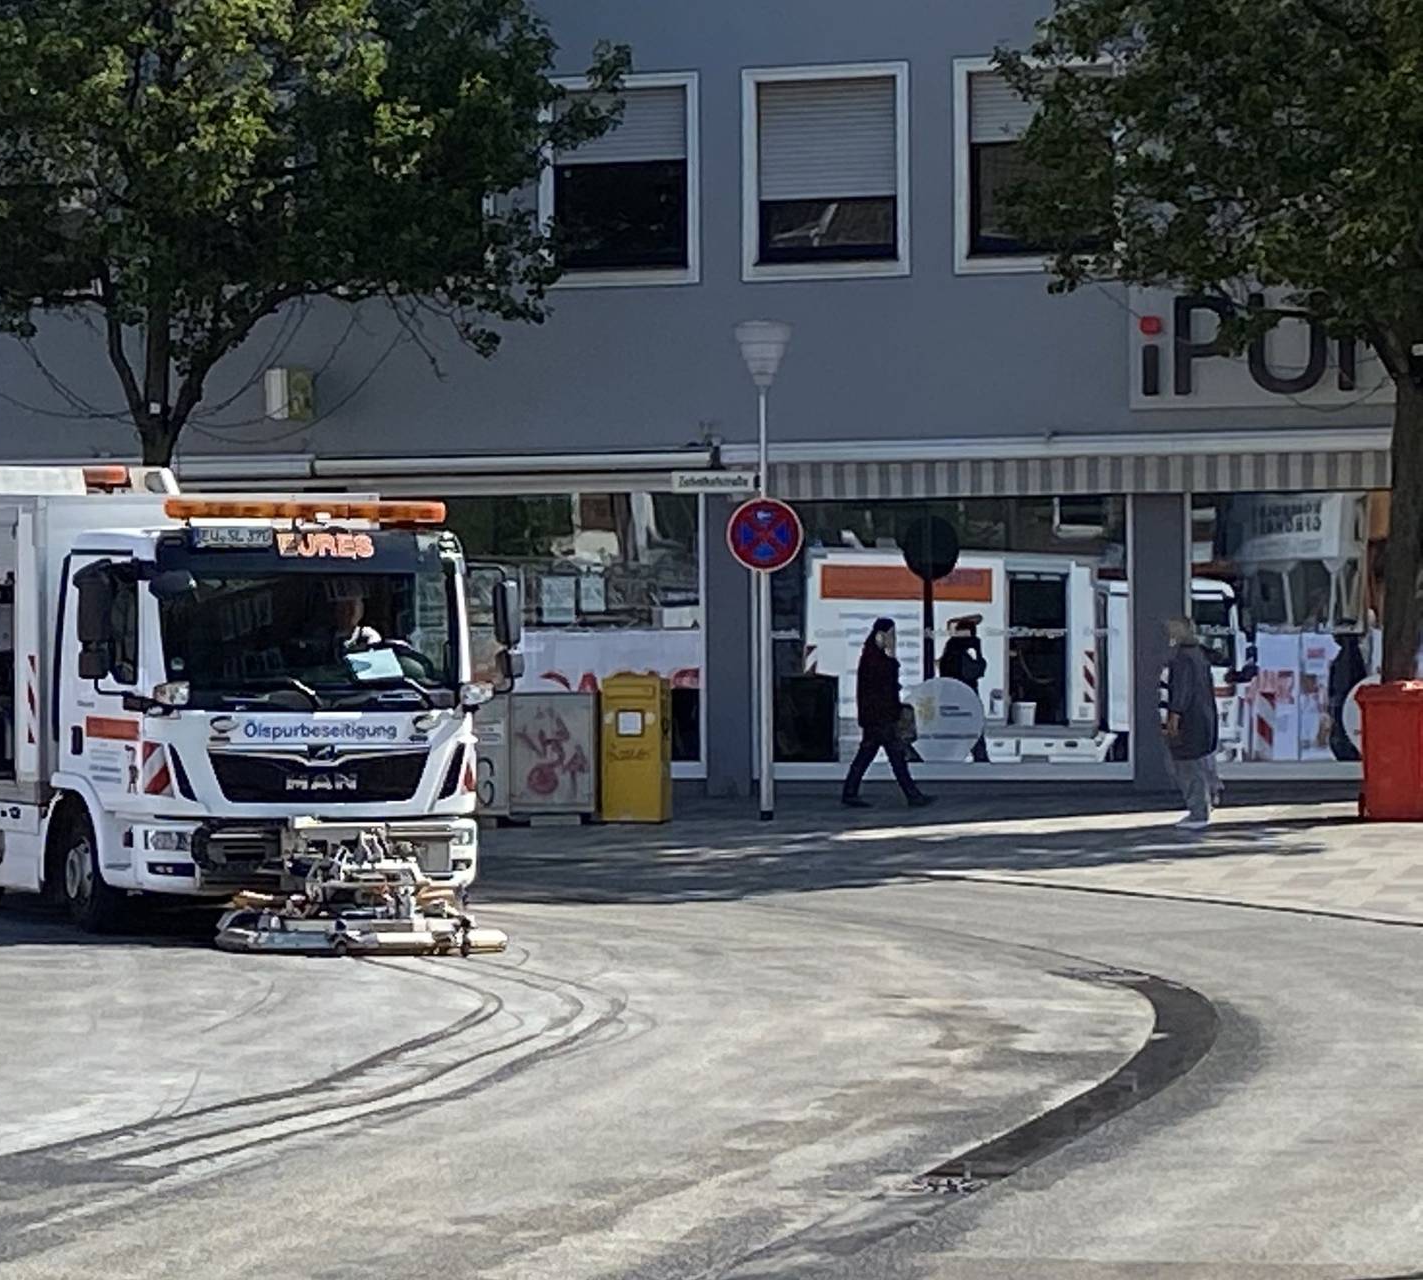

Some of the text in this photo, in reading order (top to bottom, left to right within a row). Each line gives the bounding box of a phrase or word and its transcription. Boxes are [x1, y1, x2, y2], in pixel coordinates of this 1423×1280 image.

[276, 532, 375, 558] EURES
[243, 719, 398, 740] Ölspurbeseitigung
[285, 773, 358, 791] MAN
